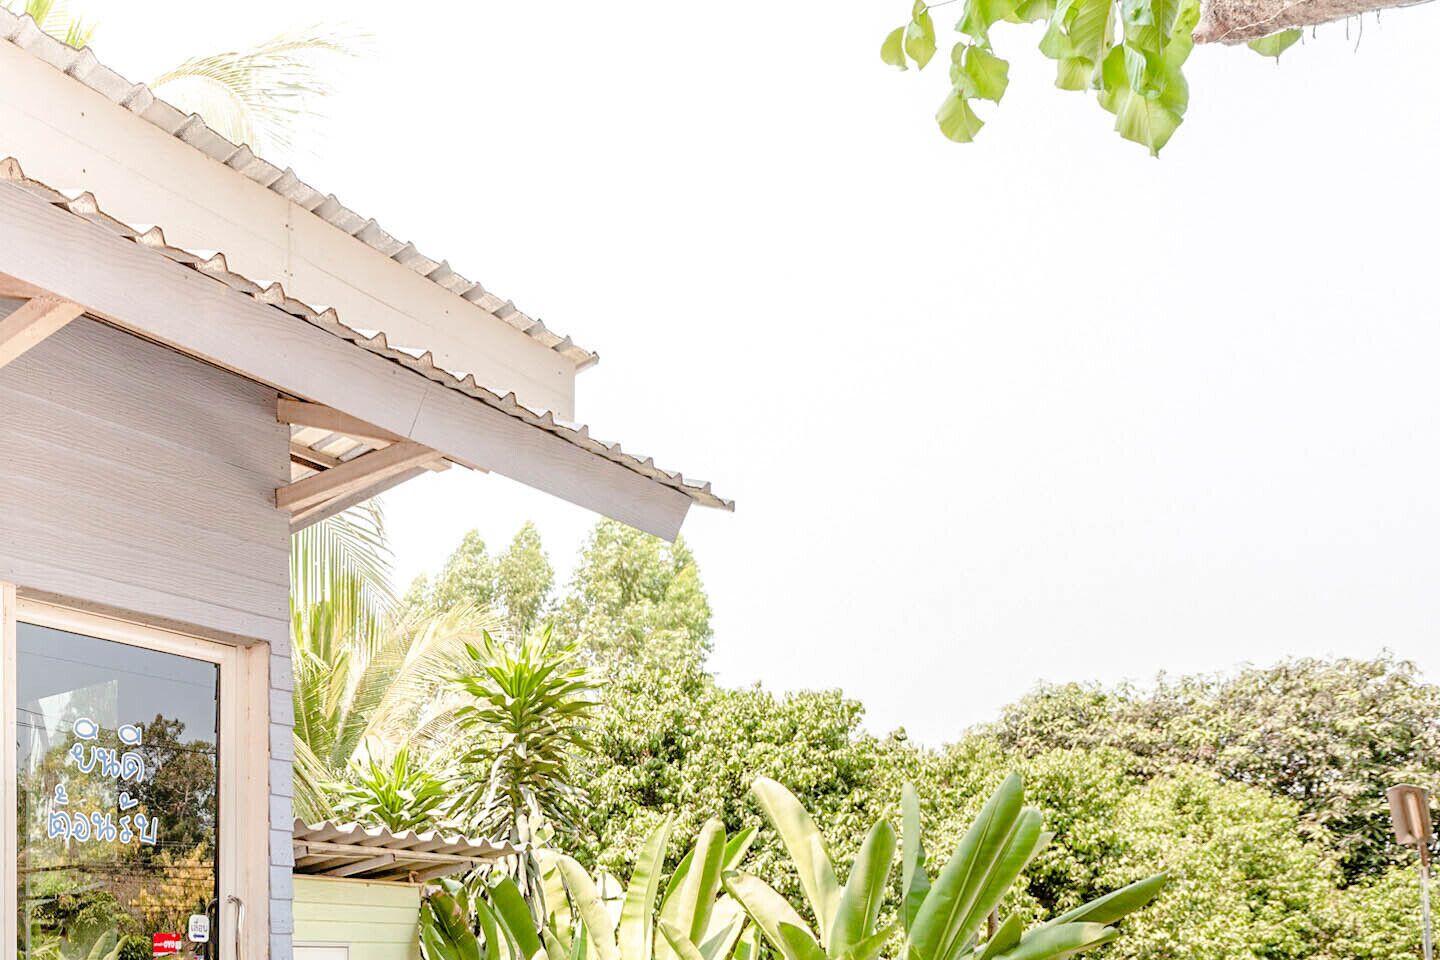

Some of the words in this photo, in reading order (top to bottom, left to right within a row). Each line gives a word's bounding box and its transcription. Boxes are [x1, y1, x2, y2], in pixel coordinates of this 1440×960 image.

[71, 717, 145, 782] ยินดี
[47, 783, 158, 845] ต้อนรับ
